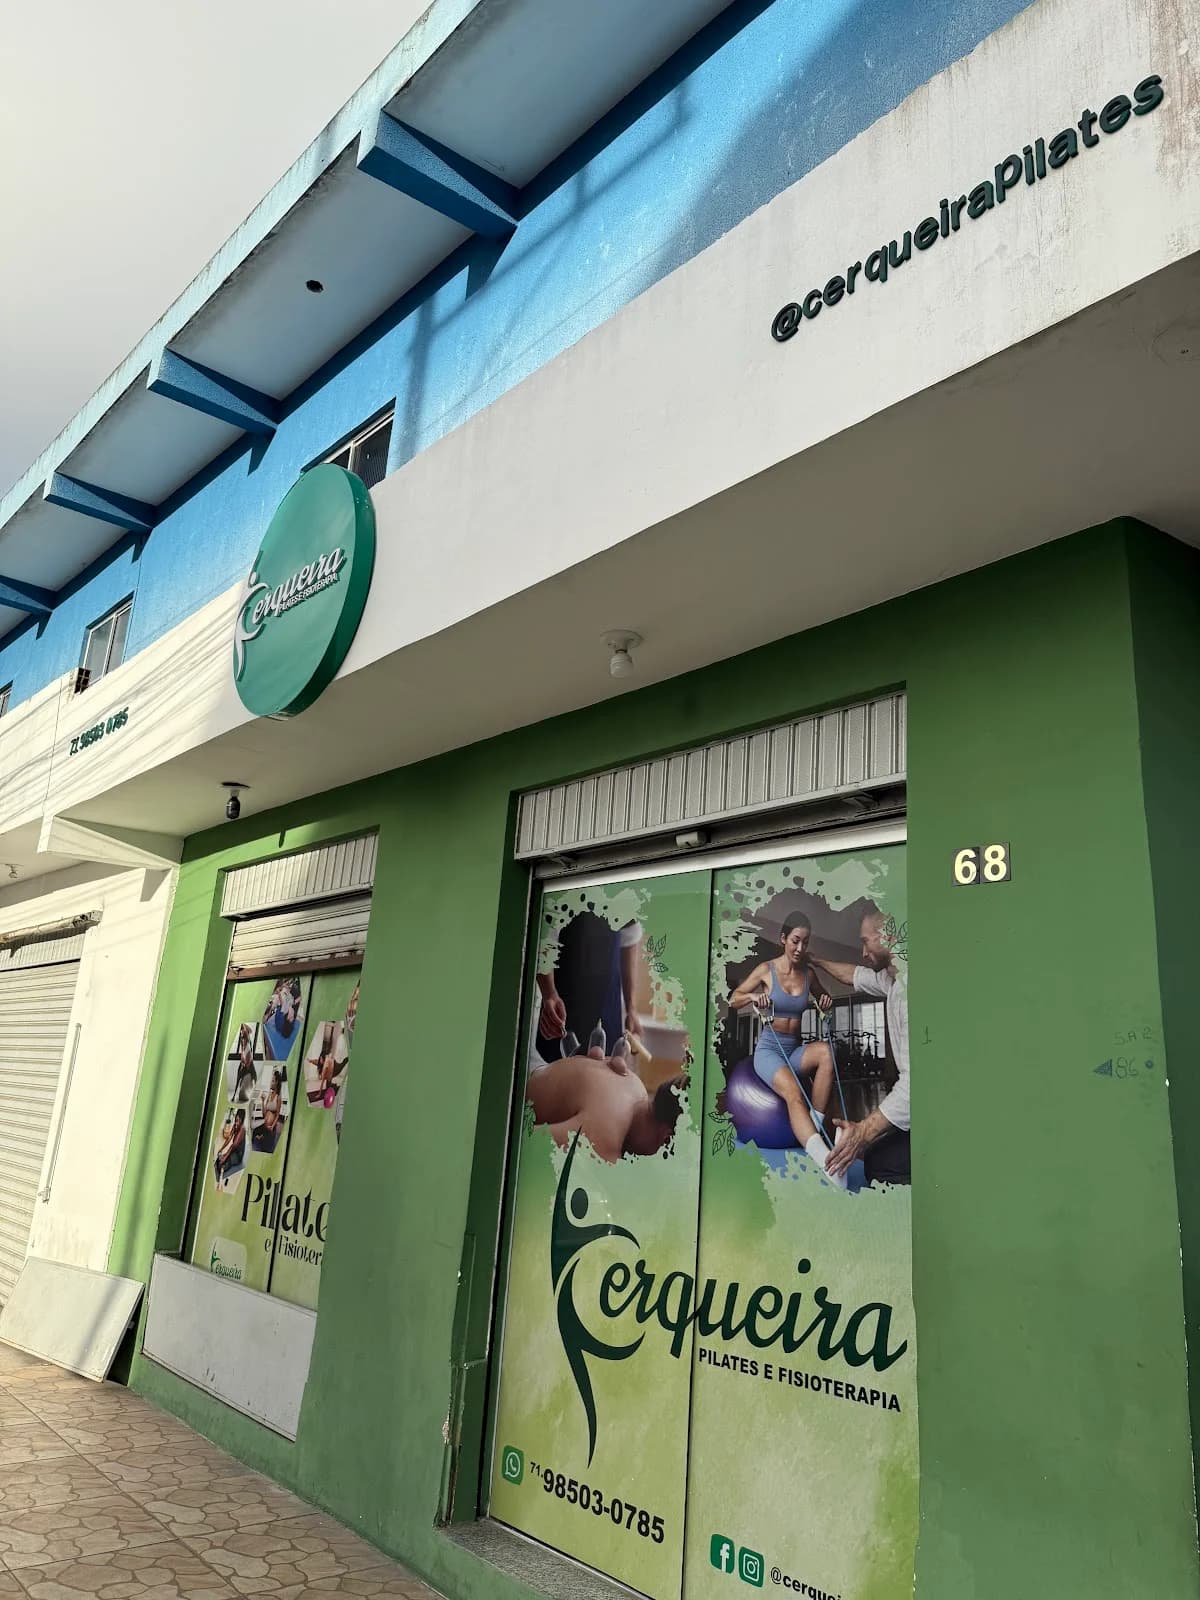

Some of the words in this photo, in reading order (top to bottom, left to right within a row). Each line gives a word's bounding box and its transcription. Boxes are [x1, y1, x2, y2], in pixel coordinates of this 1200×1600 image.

[770, 74, 1165, 343] @cerqueirapilates
[954, 844, 1007, 885] 68
[278, 1235, 323, 1267] Fisioter
[698, 1347, 759, 1377] PILATES
[764, 1363, 773, 1380] E
[778, 1366, 901, 1413] FISIOTERAPIA
